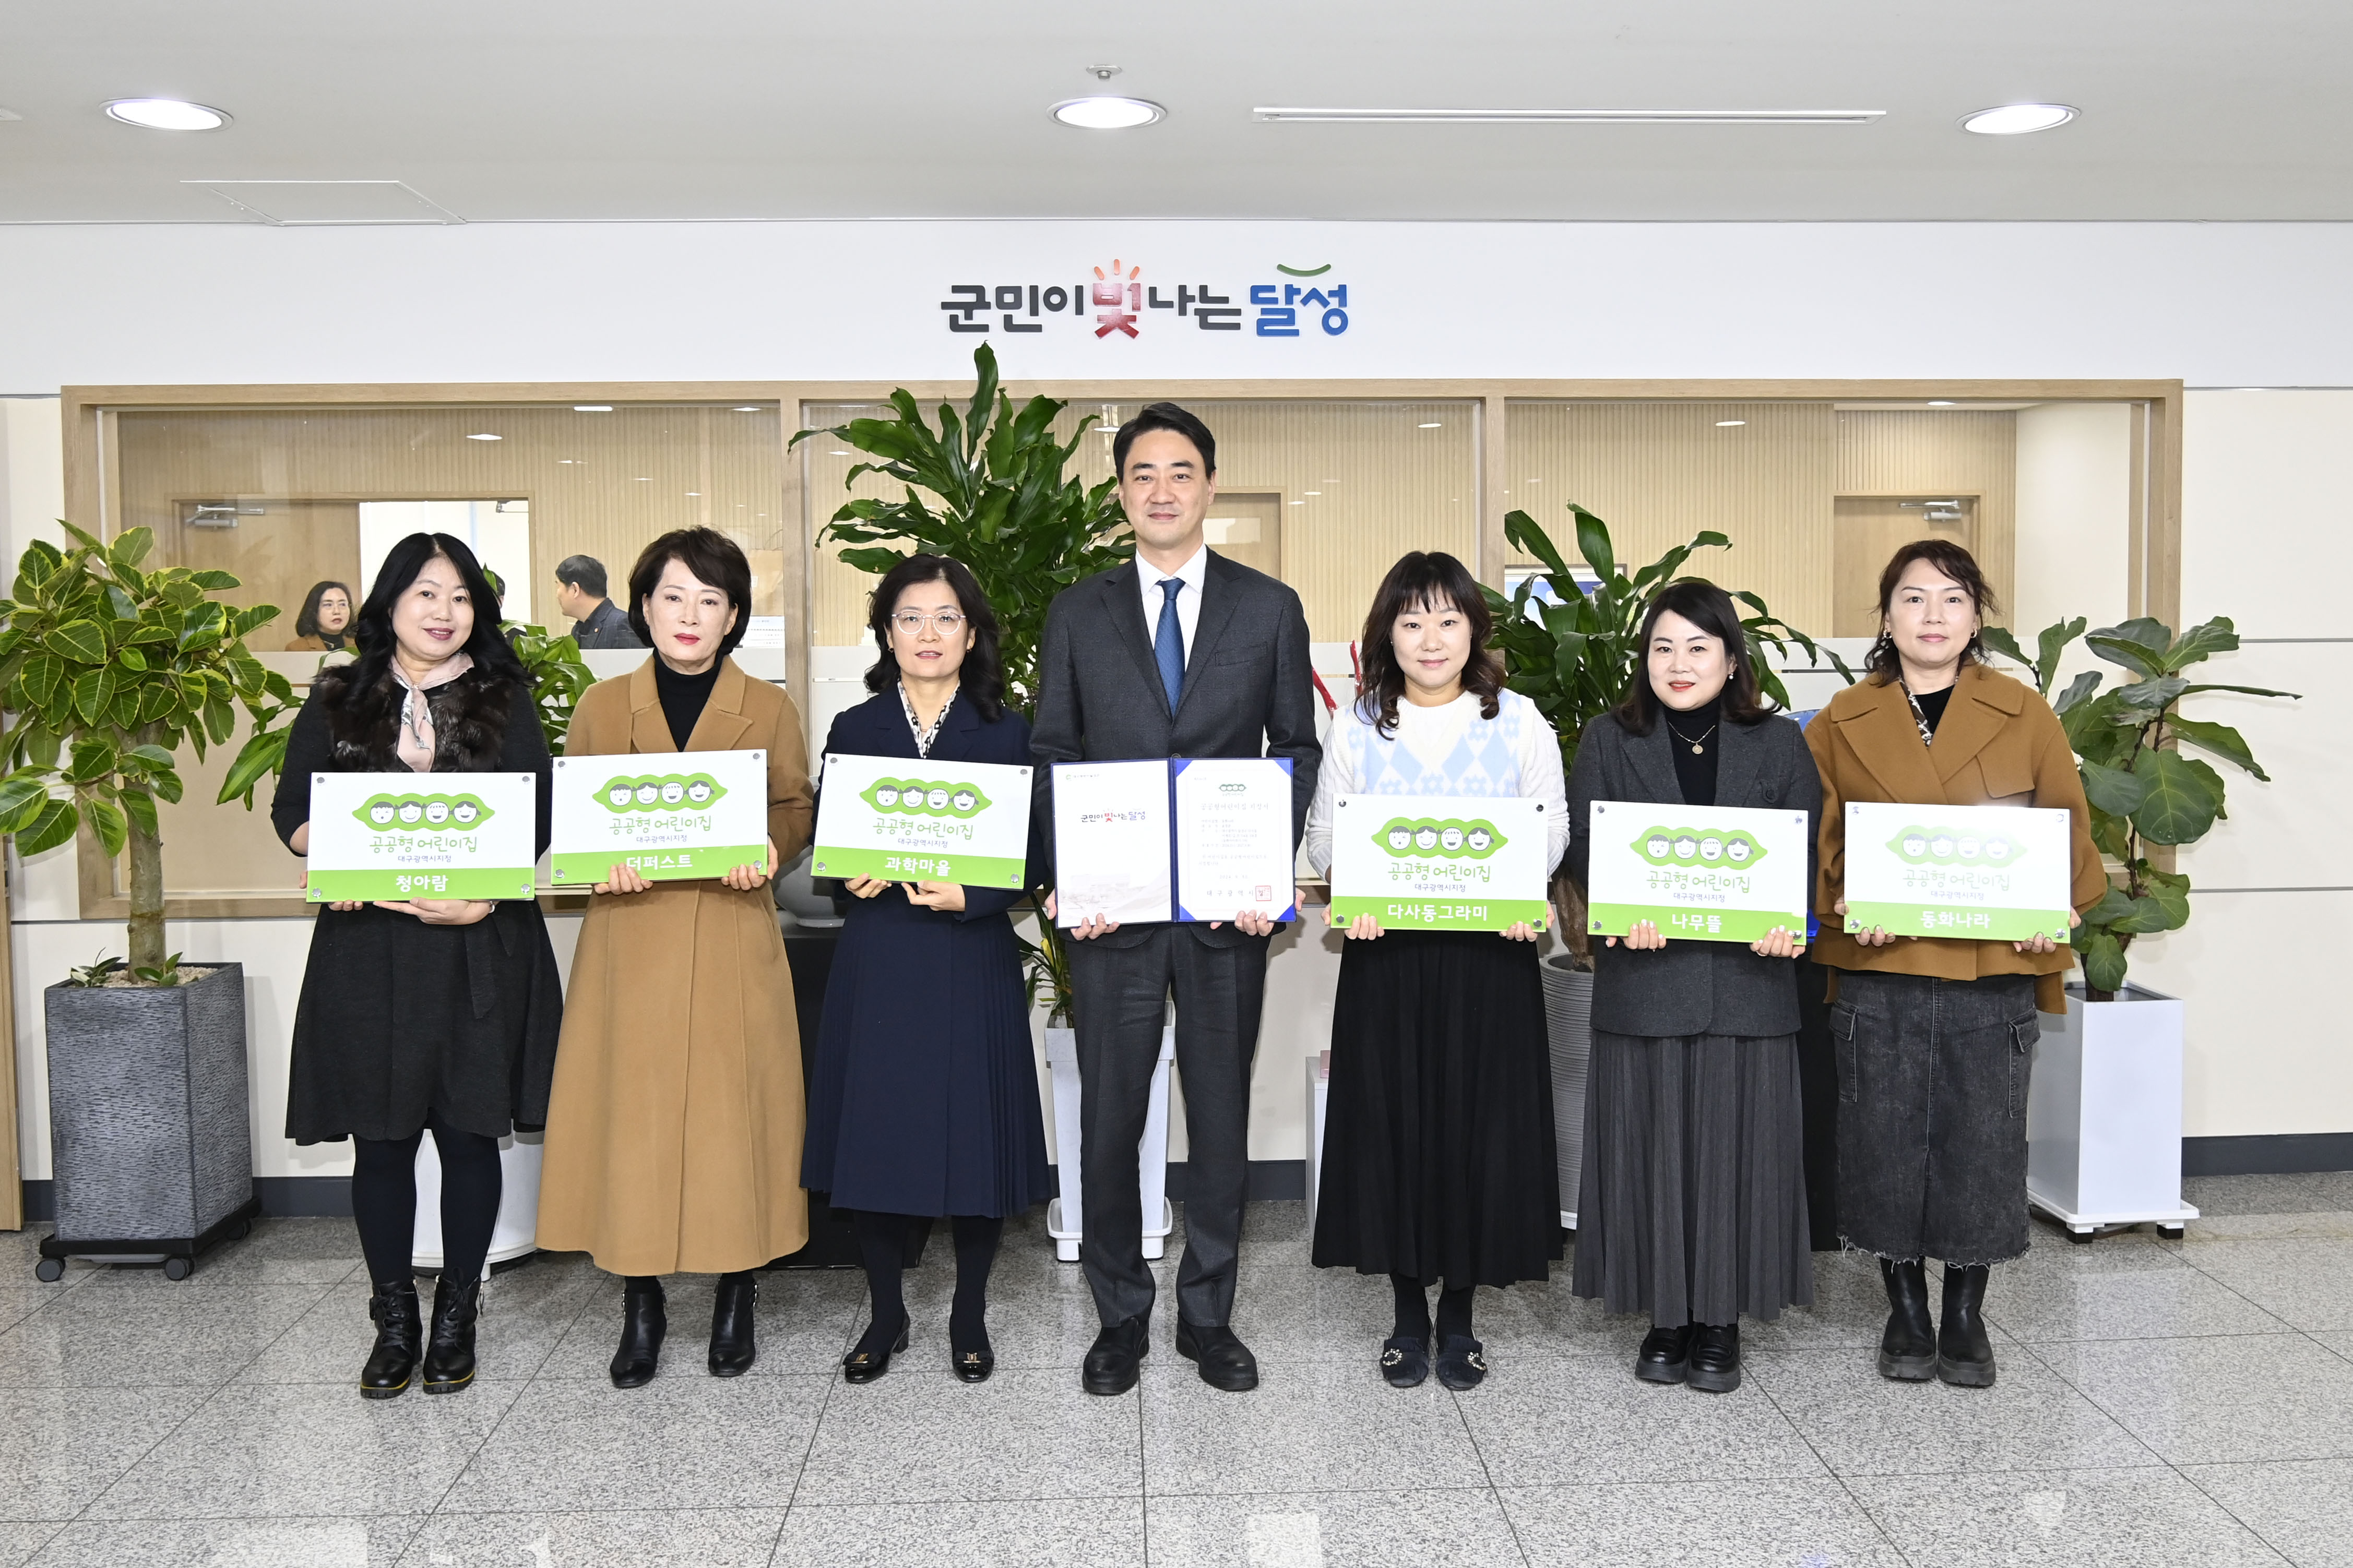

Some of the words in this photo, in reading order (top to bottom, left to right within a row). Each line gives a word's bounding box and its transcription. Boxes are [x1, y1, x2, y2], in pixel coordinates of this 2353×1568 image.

[941, 284, 1084, 333] 군민이
[1092, 282, 1242, 340] 빛나는
[1250, 284, 1349, 337] 달성
[609, 817, 650, 835] 공공형
[655, 815, 711, 832] 어린이집
[1080, 813, 1103, 823] 군민이
[1128, 811, 1146, 821] 달성
[873, 818, 913, 835] 공공형
[917, 822, 973, 840] 어린이집
[370, 836, 413, 853] 공공형
[417, 836, 477, 853] 어린이집
[636, 835, 687, 843] 대구광역시지정
[898, 838, 948, 848] 대구광역시지정
[626, 854, 693, 871] 더퍼스트
[885, 856, 951, 877] 과학마을
[1388, 863, 1429, 880] 공공형
[1433, 864, 1491, 882] 어린이집
[1903, 869, 1946, 888] 공공형
[1950, 872, 2010, 891] 어린이집
[395, 875, 448, 892] 청아람
[1415, 884, 1466, 892] 대구광역시지정
[1646, 871, 1688, 890] 공공형
[1692, 874, 1750, 893] 어린이집
[1673, 892, 1725, 903] 대구광역시지정
[1931, 891, 1984, 901] 대구광역시지정
[1387, 904, 1488, 923] 다사동그라미
[1920, 911, 1991, 929] 동화나라
[1671, 914, 1722, 933] 나무뜰
